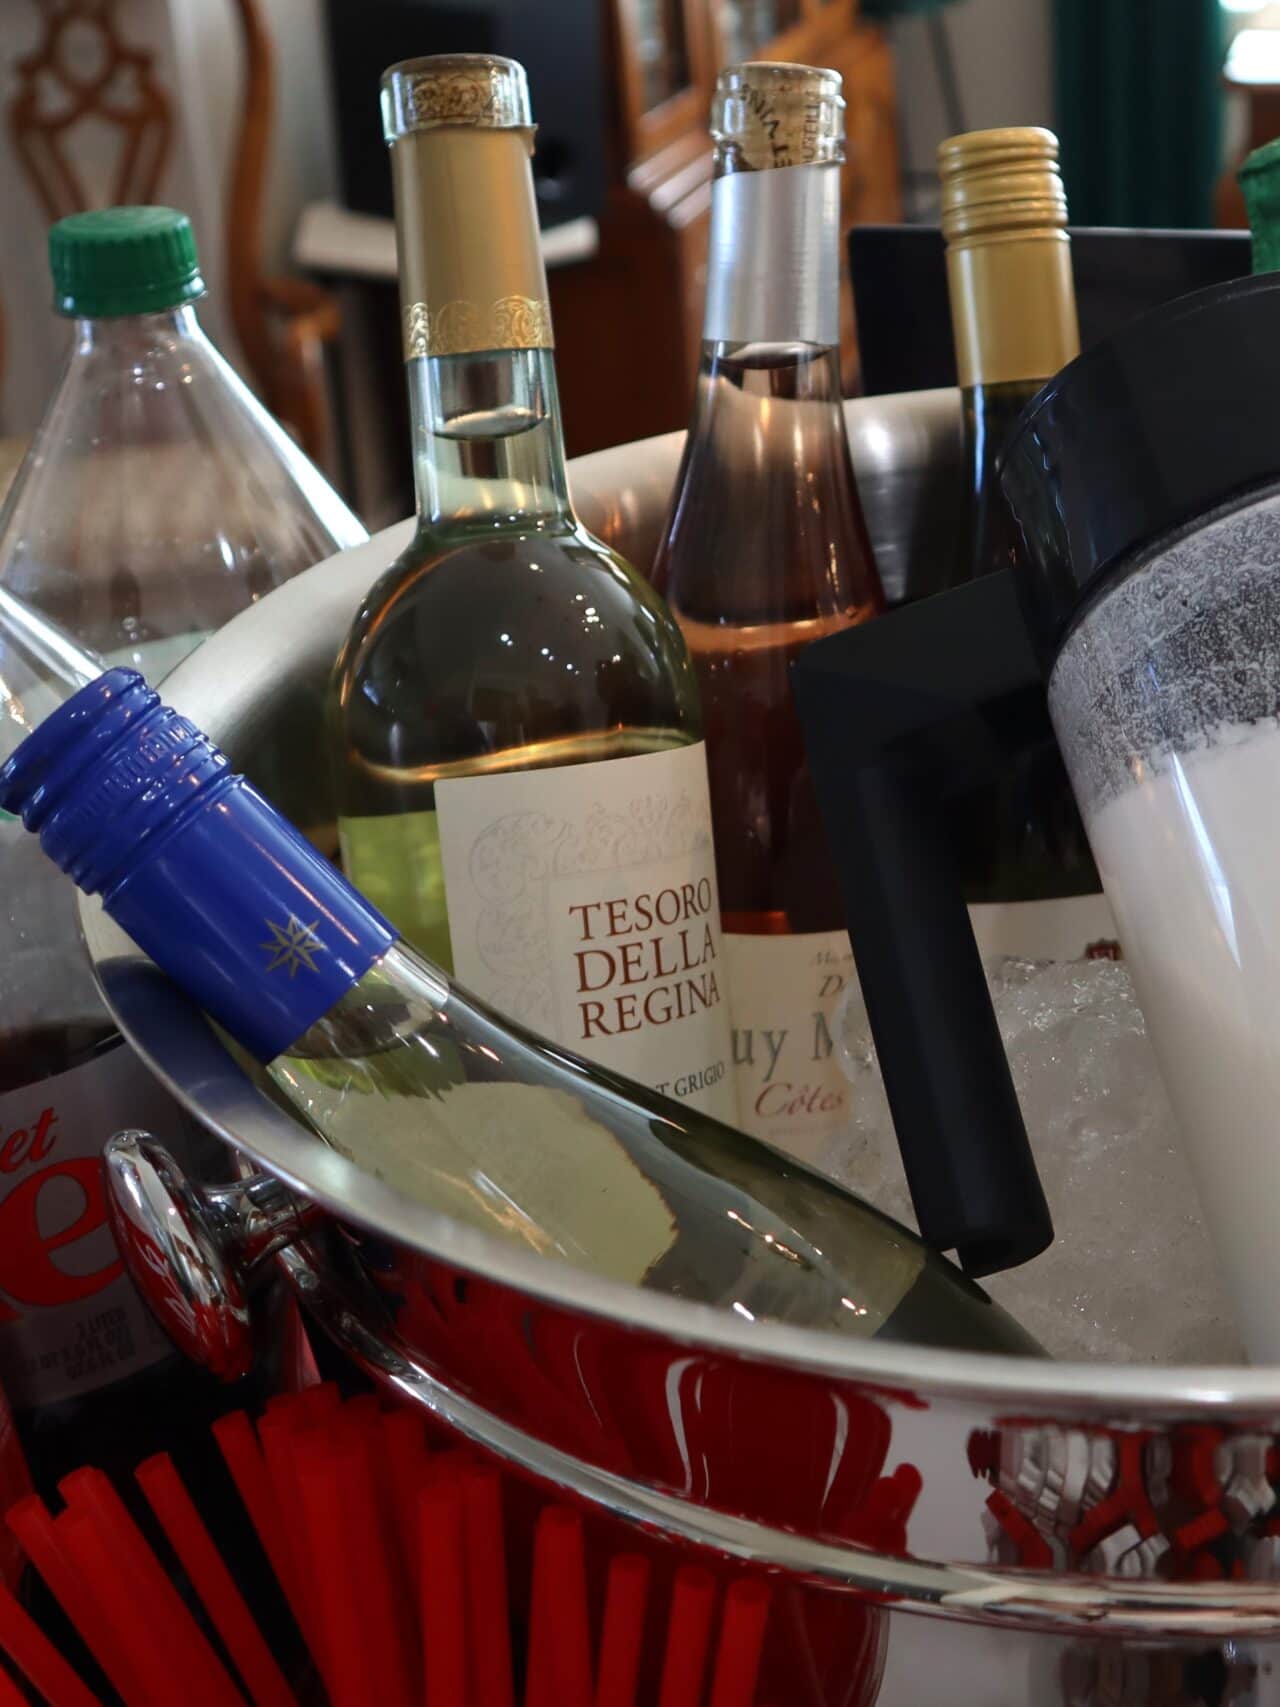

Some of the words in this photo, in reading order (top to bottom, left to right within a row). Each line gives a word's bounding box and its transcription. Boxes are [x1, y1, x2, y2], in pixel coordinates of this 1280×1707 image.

[568, 877, 712, 941] TESORO
[573, 921, 716, 993] DELLA
[578, 970, 721, 1039] REGINA
[674, 1060, 726, 1097] GRIGIO
[731, 1028, 789, 1083] uy
[0, 1107, 58, 1173] et
